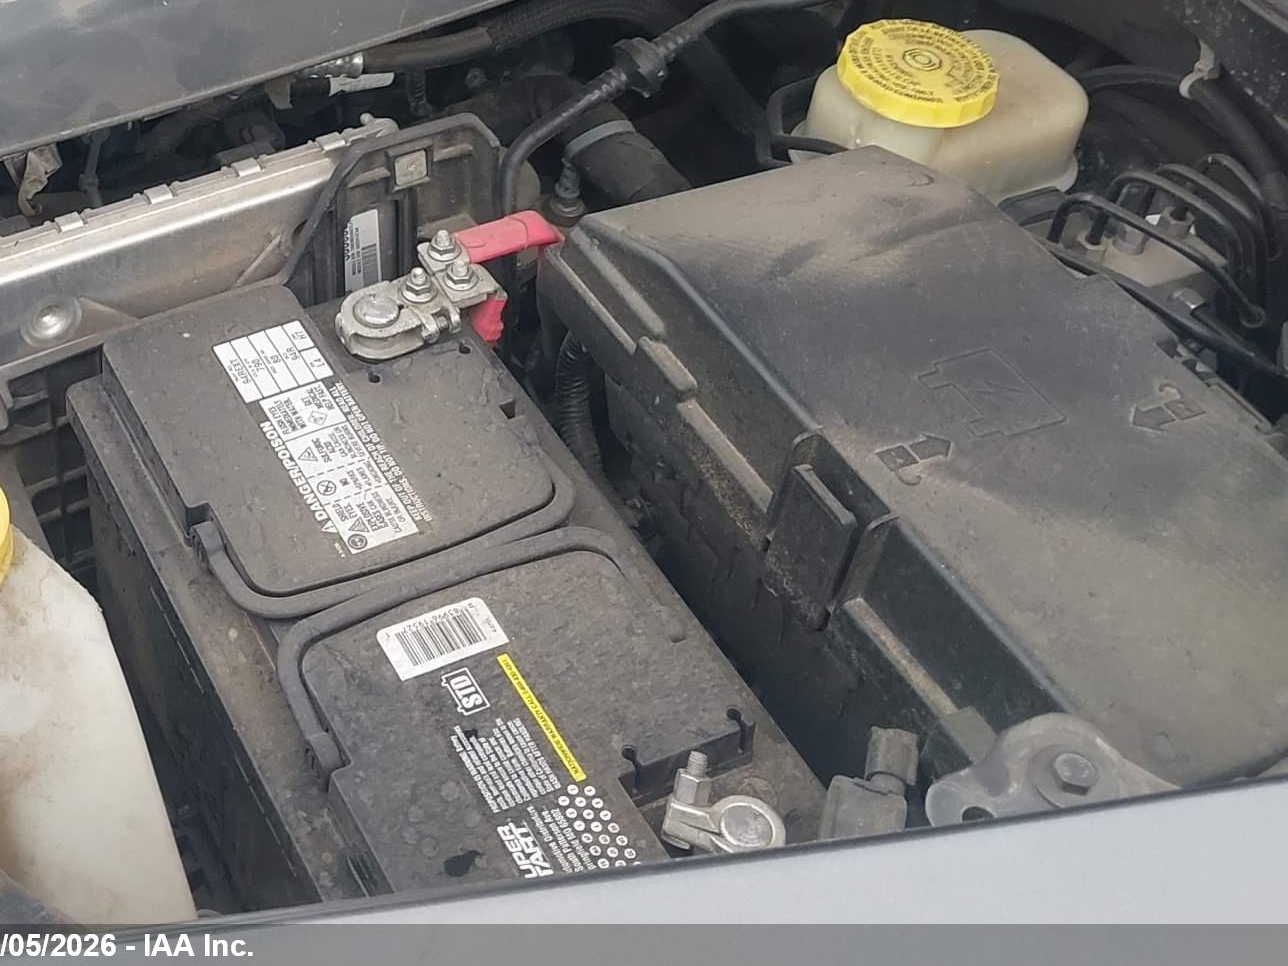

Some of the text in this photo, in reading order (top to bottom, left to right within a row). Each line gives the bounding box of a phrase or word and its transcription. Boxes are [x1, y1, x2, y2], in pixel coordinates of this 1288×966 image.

[258, 419, 329, 521] DANGER/POISON
[451, 674, 483, 709] STD
[526, 740, 542, 757] AFTER
[549, 806, 569, 829] 65802
[495, 822, 538, 882] UPER
[507, 817, 555, 880] TART
[547, 821, 573, 854] Patterson
[569, 837, 597, 872] pringfield
[546, 840, 573, 876] utomotive
